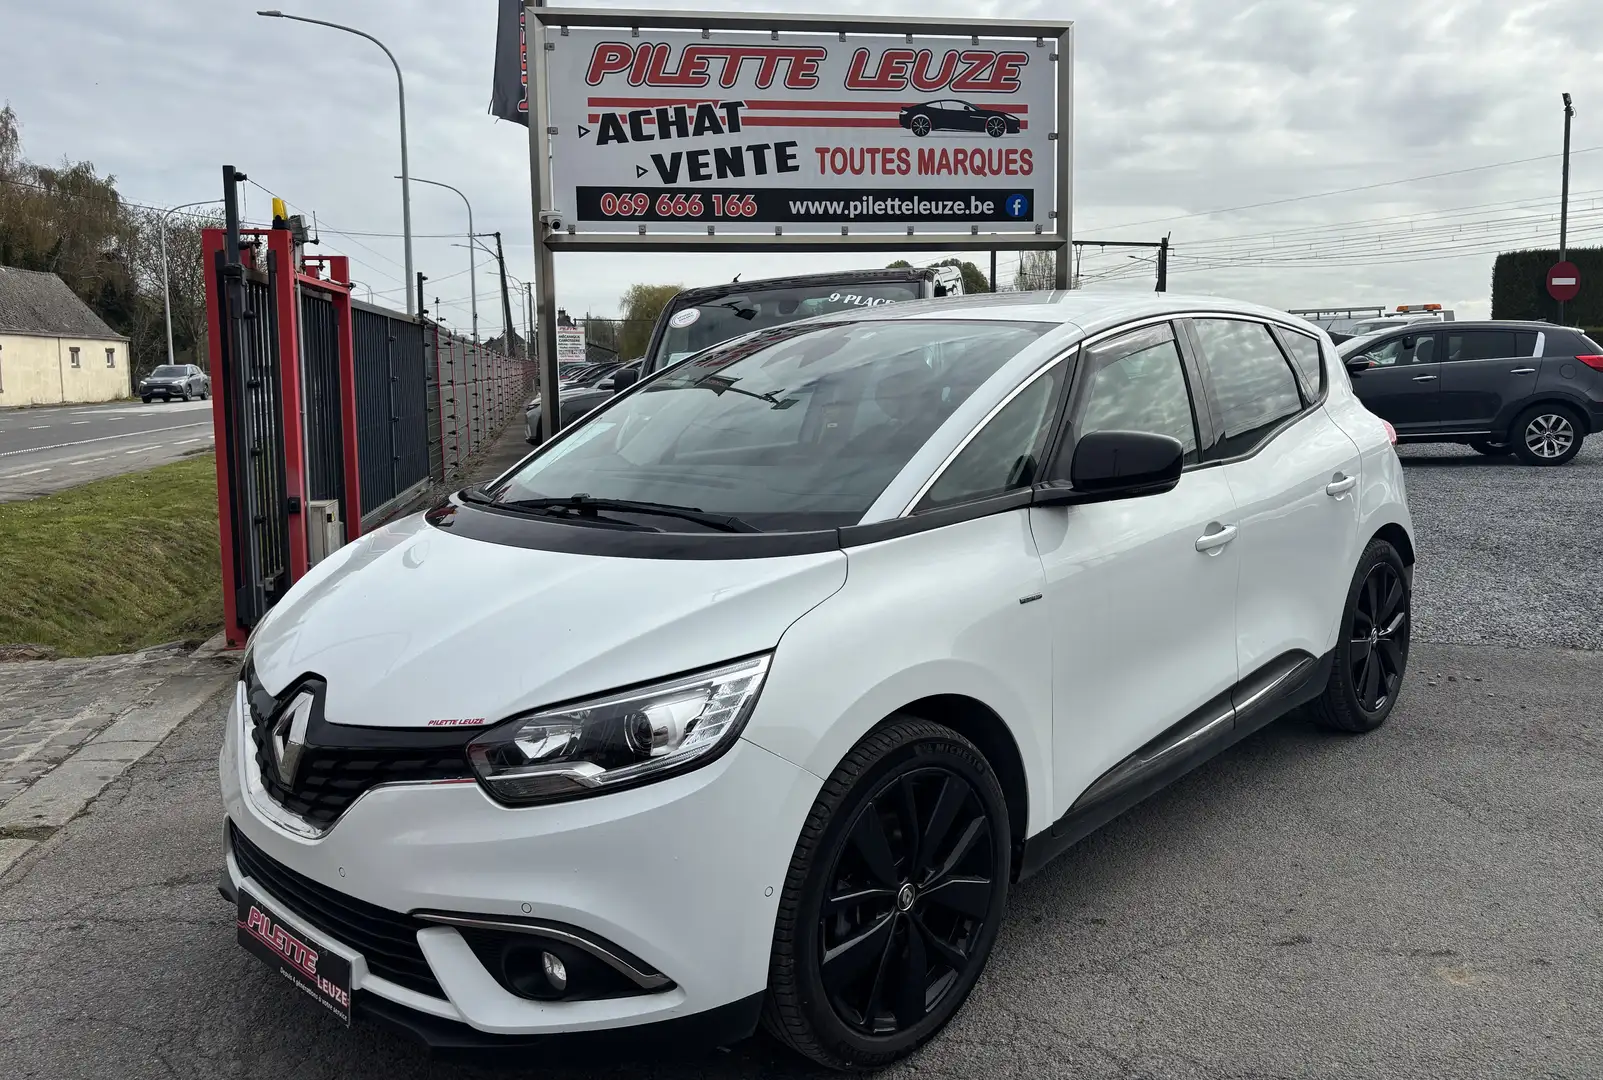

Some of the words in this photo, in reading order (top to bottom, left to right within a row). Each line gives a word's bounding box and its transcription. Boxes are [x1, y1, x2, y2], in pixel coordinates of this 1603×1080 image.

[585, 41, 828, 90] PILETTE
[844, 47, 1030, 93] LEUZE
[596, 100, 747, 146] ACHAT
[650, 140, 800, 185] VENTE
[815, 146, 912, 176] TOUTES
[917, 147, 1034, 177] MARQUES
[600, 192, 650, 216] 069
[655, 192, 705, 217] 666
[712, 194, 758, 218] 166
[788, 195, 995, 219] www.piletteleuze.be
[828, 292, 841, 303] 9
[248, 905, 319, 974] PILETTE
[317, 973, 349, 1008] LEUZE
